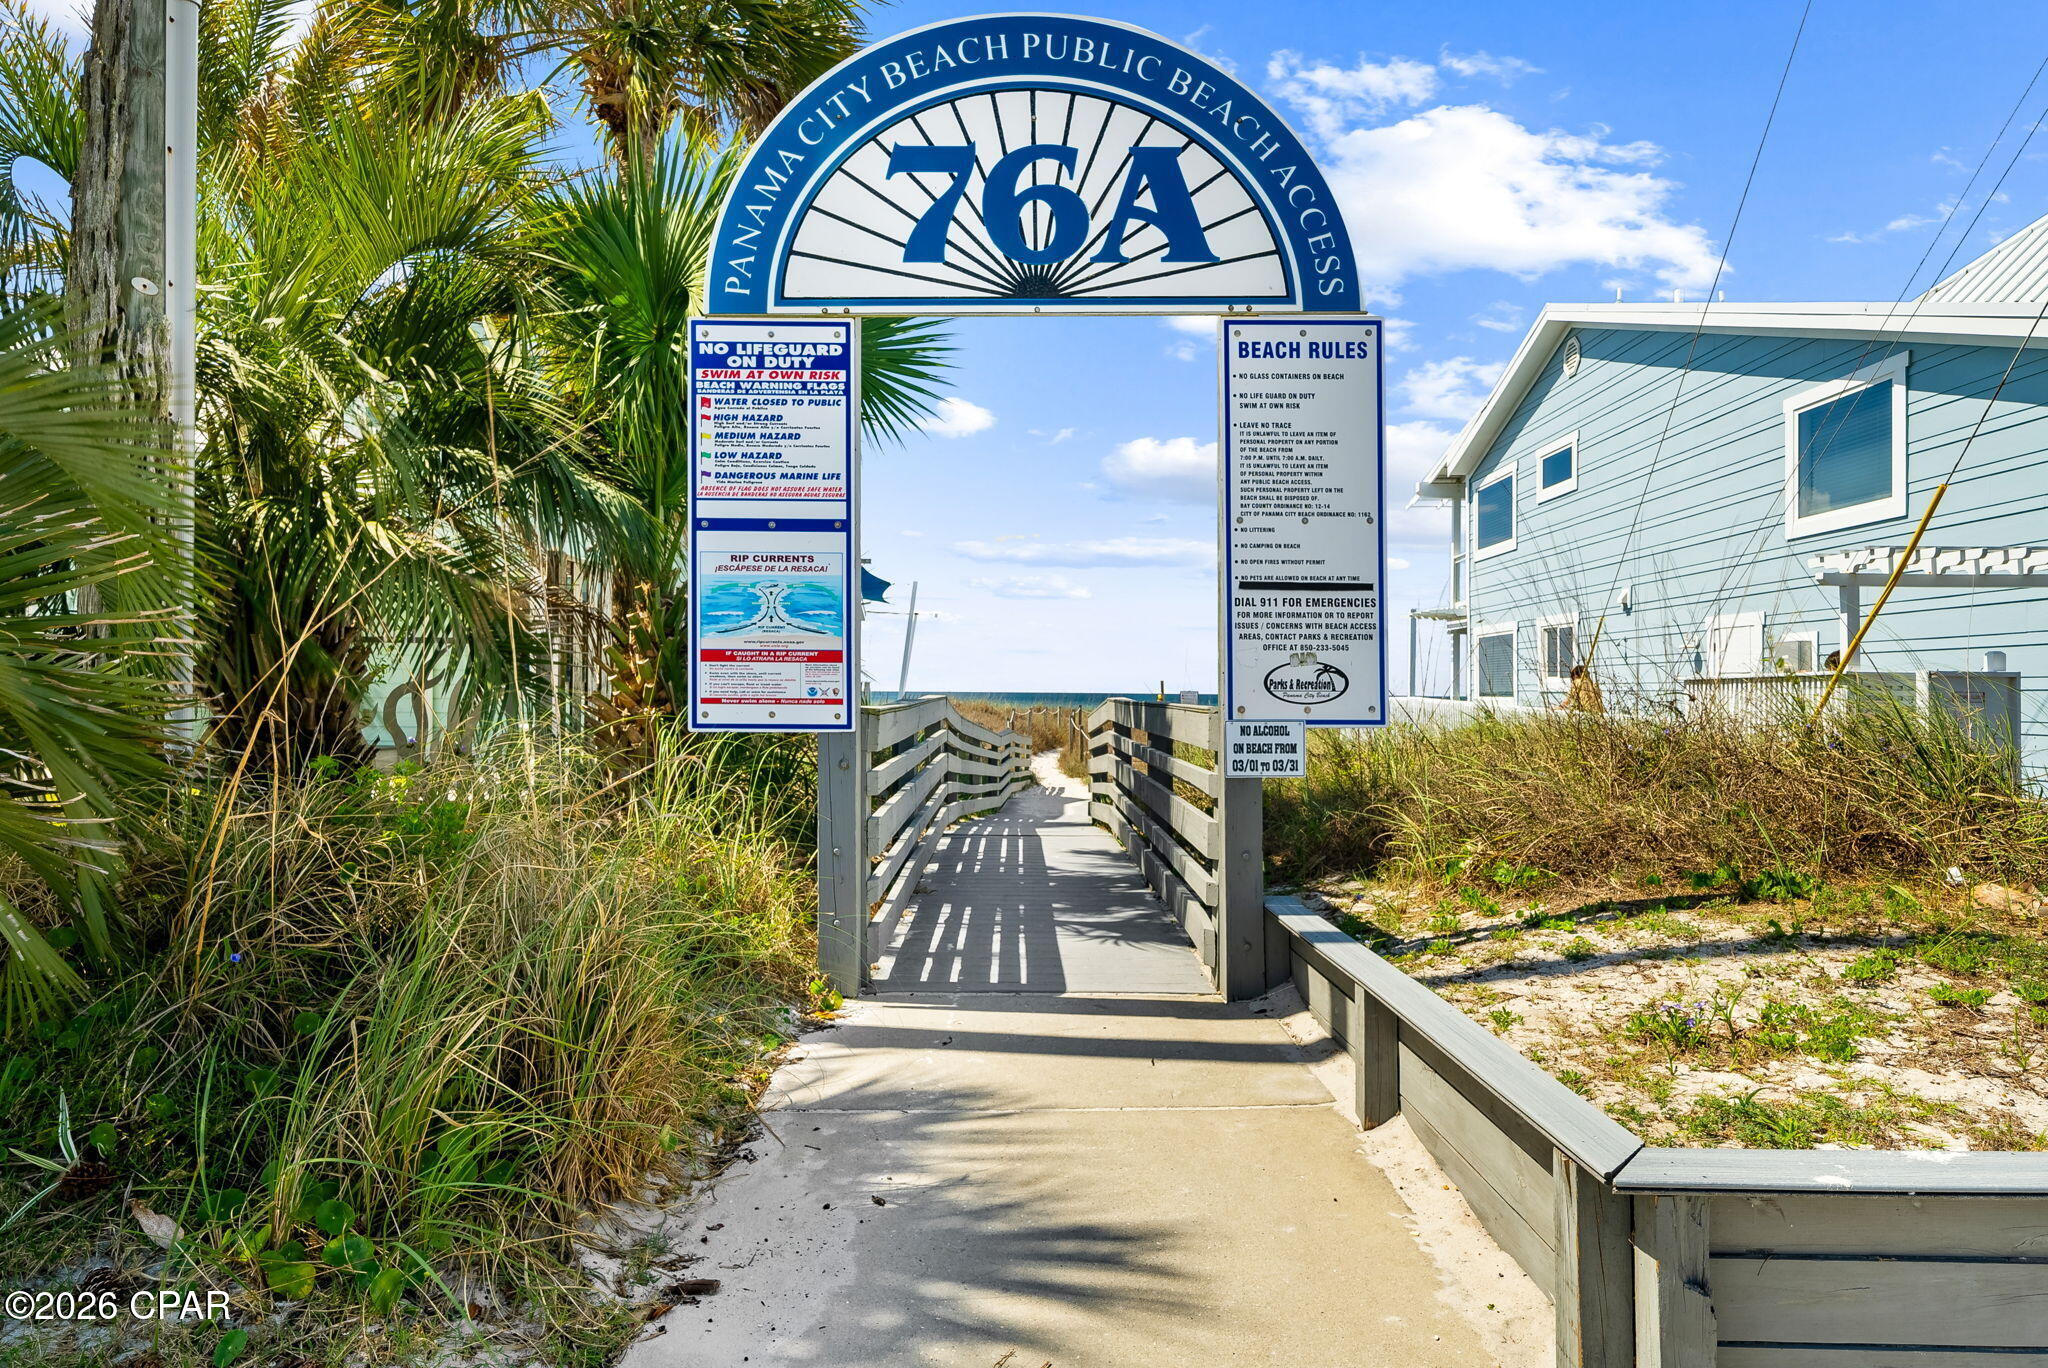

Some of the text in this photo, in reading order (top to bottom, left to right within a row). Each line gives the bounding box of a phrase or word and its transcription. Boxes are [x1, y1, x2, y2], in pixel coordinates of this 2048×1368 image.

[725, 34, 1345, 298] PANAMA CITY BEACH PUBLIC BEACH ACCESS
[885, 141, 1221, 264] 76A
[699, 343, 842, 356] NO LIFEGUARD
[1239, 342, 1367, 359] BEACH RULES
[727, 356, 815, 368] ON DUTY
[701, 370, 840, 379] SWIM AT OWN RISK
[715, 564, 762, 572] ¡ESCÁPESE
[1235, 598, 1376, 607] DIAL 911 FOR EMERGENCIES
[1270, 679, 1331, 690] Parks & Recreation
[1240, 726, 1290, 736] NO ALCOHOL
[1234, 743, 1297, 753] ON BEACH FROM
[1233, 759, 1258, 772] 03/01
[1273, 759, 1298, 772] 03/31
